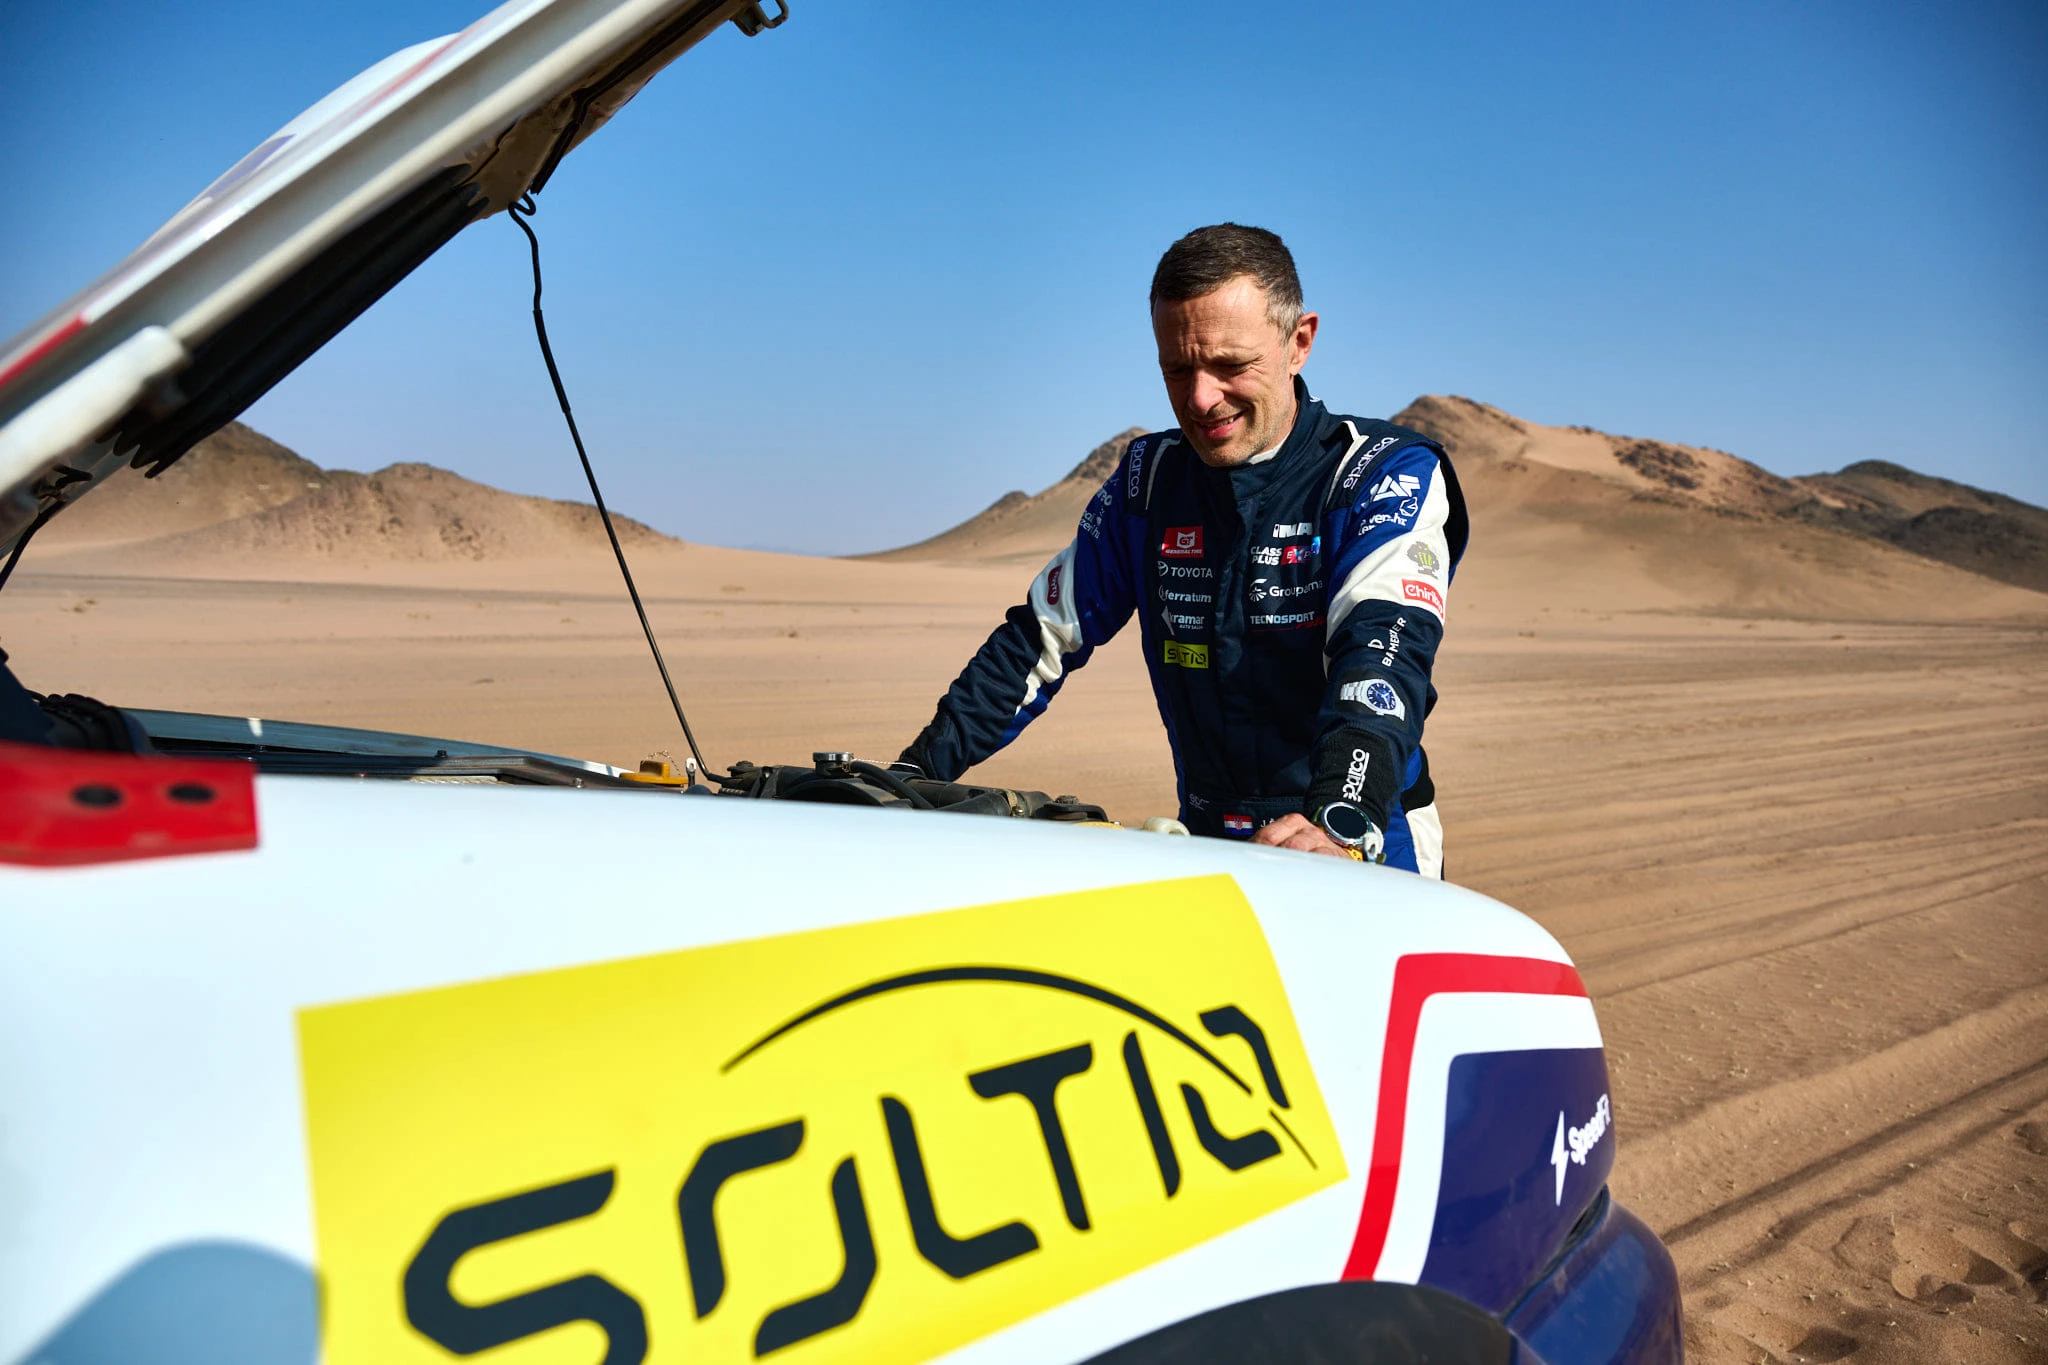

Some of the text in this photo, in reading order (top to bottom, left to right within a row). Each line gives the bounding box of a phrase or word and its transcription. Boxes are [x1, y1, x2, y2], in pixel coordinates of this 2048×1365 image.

[1130, 441, 1147, 498] sparco
[1343, 437, 1395, 489] sparco
[1250, 546, 1283, 556] CLASS
[1252, 556, 1280, 565] PLUS
[1170, 567, 1213, 578] TOYOTA
[1269, 581, 1322, 597] Groupama
[1165, 590, 1212, 603] ferratum
[1249, 611, 1315, 625] TECNOSPORT
